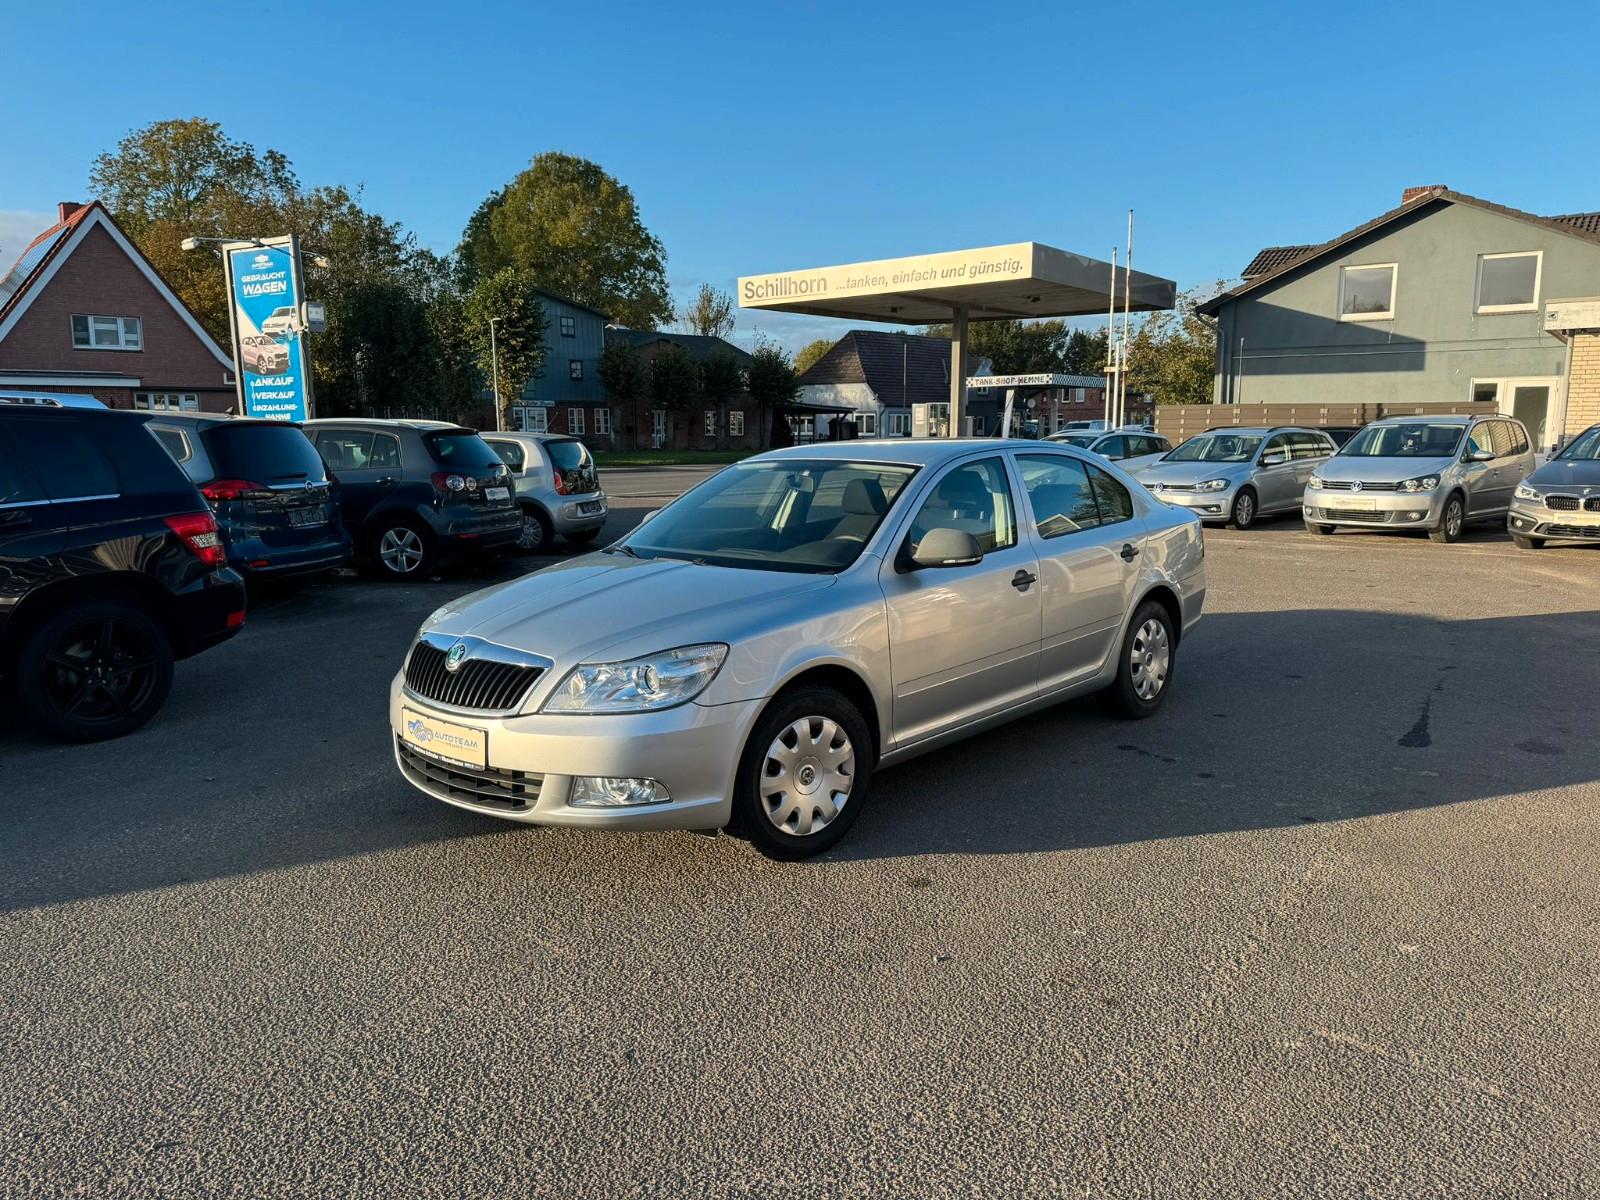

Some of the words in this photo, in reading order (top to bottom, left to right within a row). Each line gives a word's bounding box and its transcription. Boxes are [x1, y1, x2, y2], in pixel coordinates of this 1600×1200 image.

[241, 271, 286, 283] GEBRAUCHT
[744, 277, 828, 299] Schillhorn
[892, 267, 937, 285] einfach
[940, 263, 966, 279] und
[969, 258, 1024, 279] günstig.
[243, 280, 287, 295] WAGEN
[255, 376, 294, 387] ANKAUF
[255, 391, 295, 400] VERKAUF
[433, 731, 478, 749] AUTOTEAM
